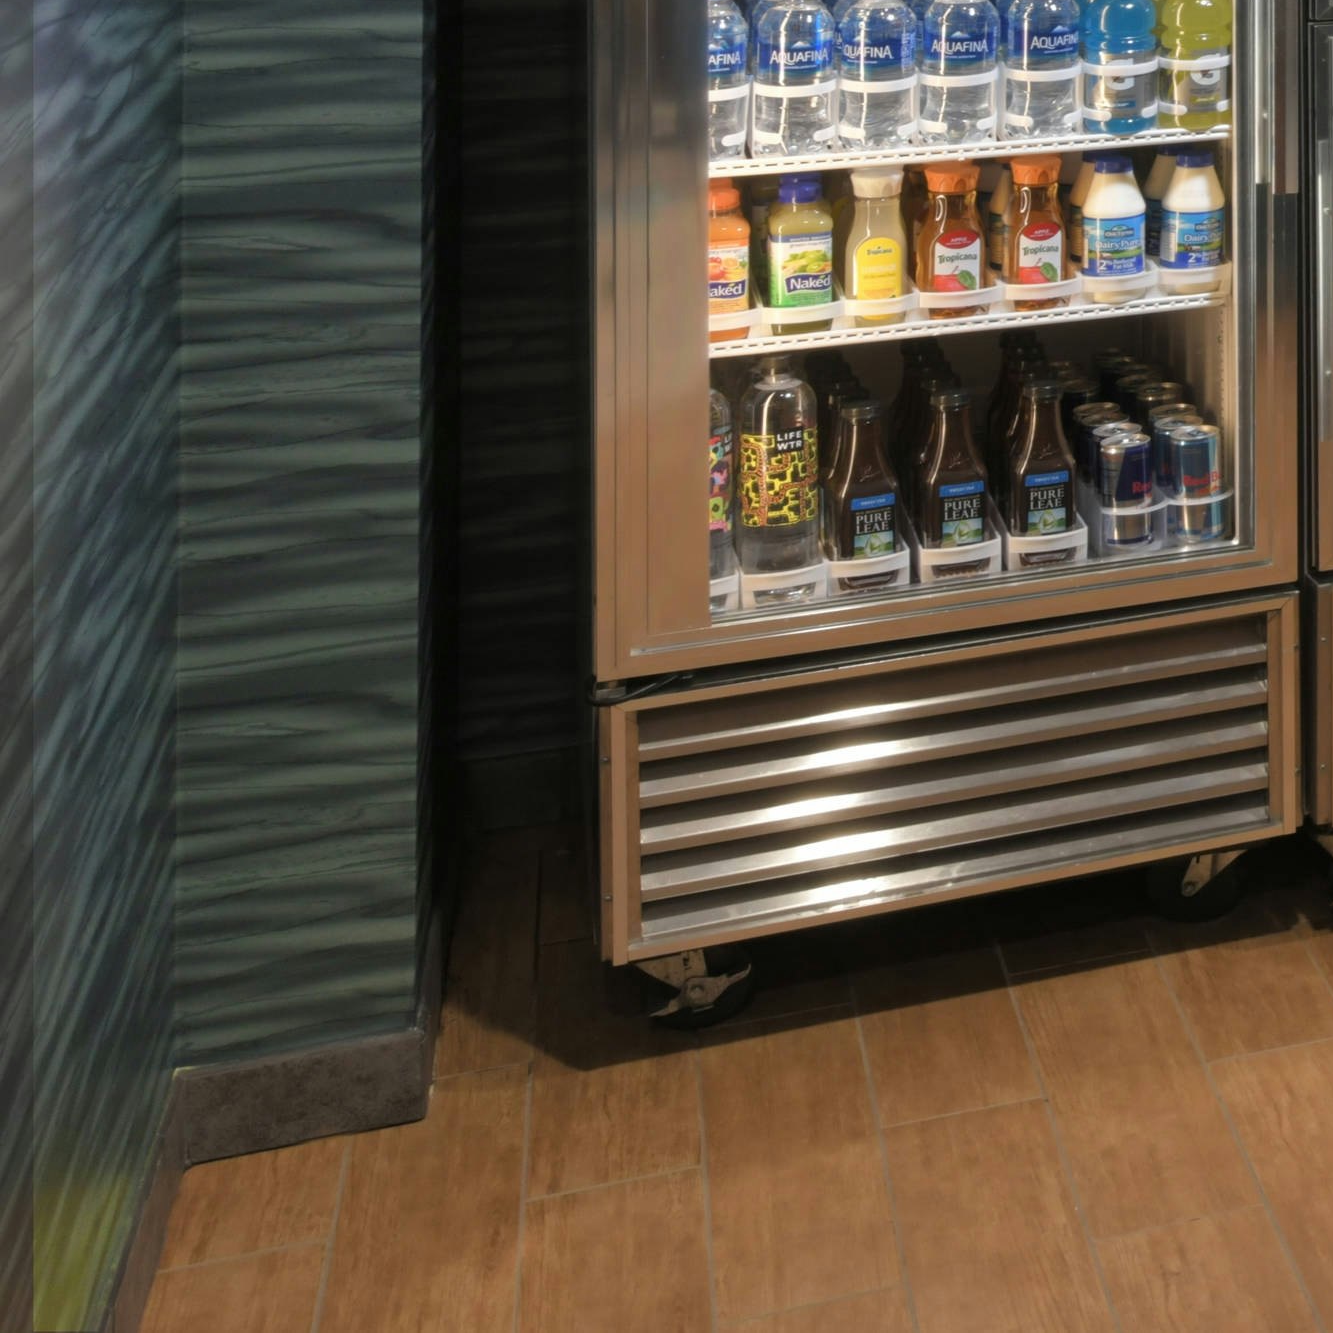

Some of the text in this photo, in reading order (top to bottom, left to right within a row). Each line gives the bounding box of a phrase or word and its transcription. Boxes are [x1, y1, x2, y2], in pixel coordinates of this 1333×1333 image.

[931, 38, 988, 55] AQUAFINA
[708, 52, 742, 65] AFINA
[769, 48, 829, 65] AQUAFINA
[1022, 244, 1060, 257] Tropicana
[937, 252, 978, 265] Tropicana
[789, 273, 832, 290] Naked
[709, 282, 742, 297] aked
[777, 429, 803, 441] LIFE
[777, 439, 803, 451] WTR
[1029, 488, 1065, 501] PURE
[944, 497, 981, 512] PURE
[1029, 498, 1063, 510] LEAF
[855, 510, 892, 525] PURE
[944, 508, 978, 521] LEAF
[856, 522, 889, 535] LEAF
